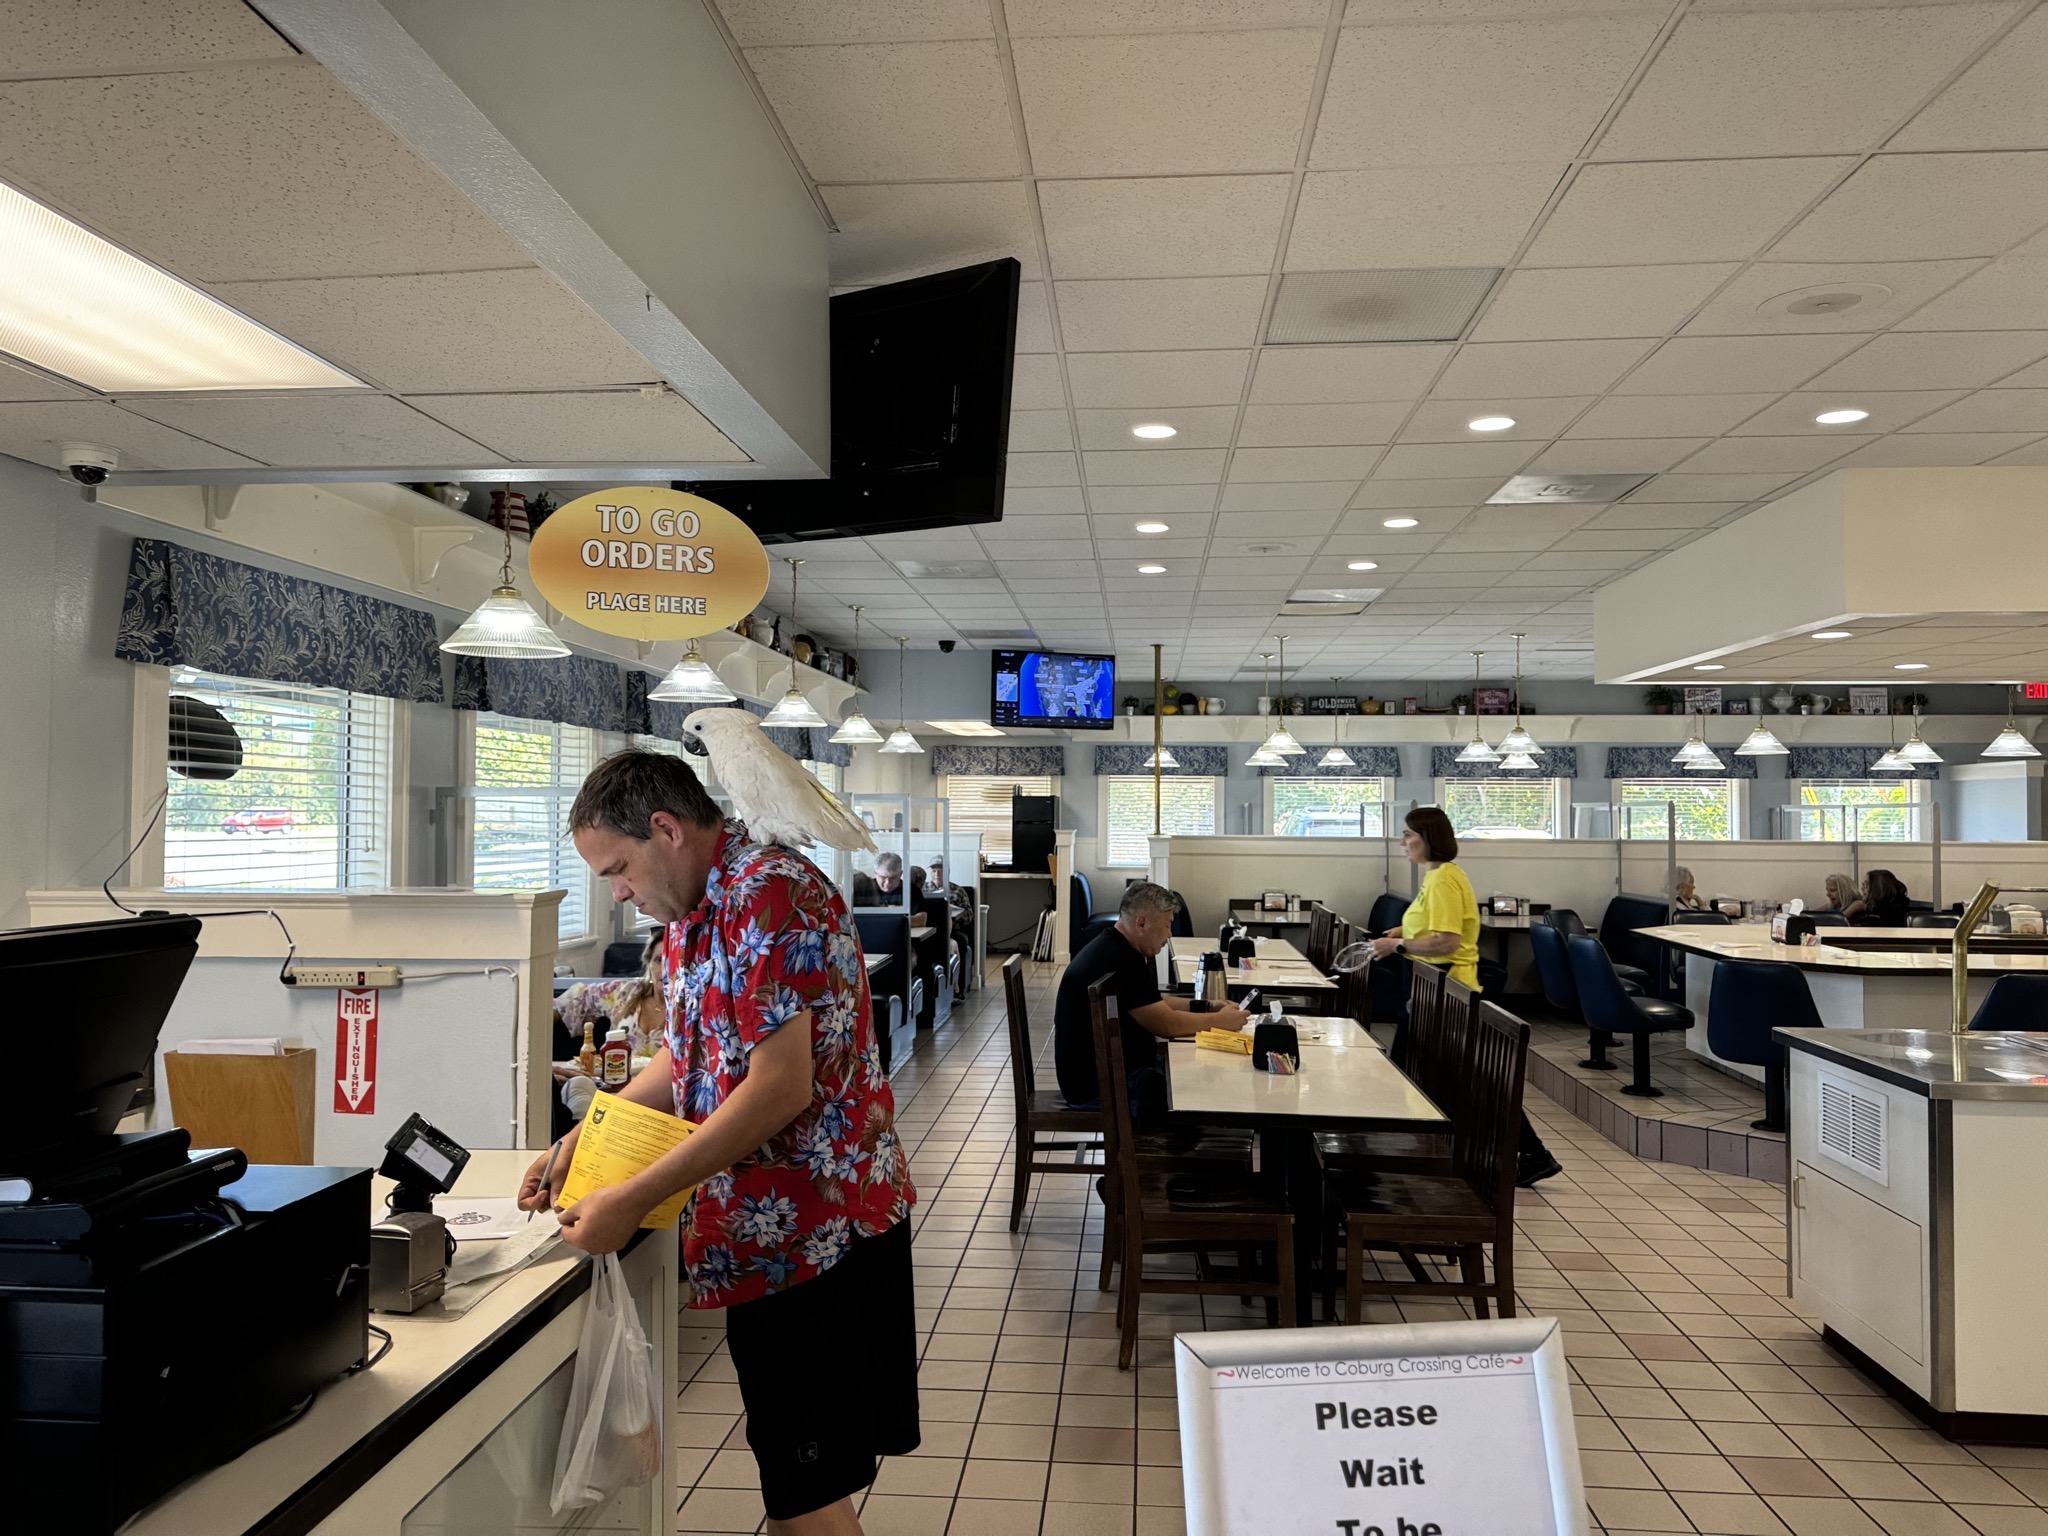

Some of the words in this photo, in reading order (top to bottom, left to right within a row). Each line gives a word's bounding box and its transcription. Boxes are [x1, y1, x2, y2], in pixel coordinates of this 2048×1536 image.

[596, 505, 641, 534] TO
[651, 509, 700, 539] GO
[581, 539, 715, 574] ORDERS
[586, 592, 650, 612] PLACE
[656, 595, 706, 615] HERE
[1318, 698, 1336, 709] OLD
[344, 998, 372, 1015] FIRE
[351, 1017, 361, 1101] EXTINGUISHER
[1236, 1365, 1310, 1380] Welcome
[1315, 1363, 1331, 1378] to
[1335, 1360, 1394, 1377] Coburg
[1399, 1357, 1462, 1375] Crossing
[1466, 1354, 1505, 1370] Café
[1315, 1402, 1438, 1431] Please
[1340, 1457, 1426, 1488] Wait
[1396, 1517, 1443, 1536] be
